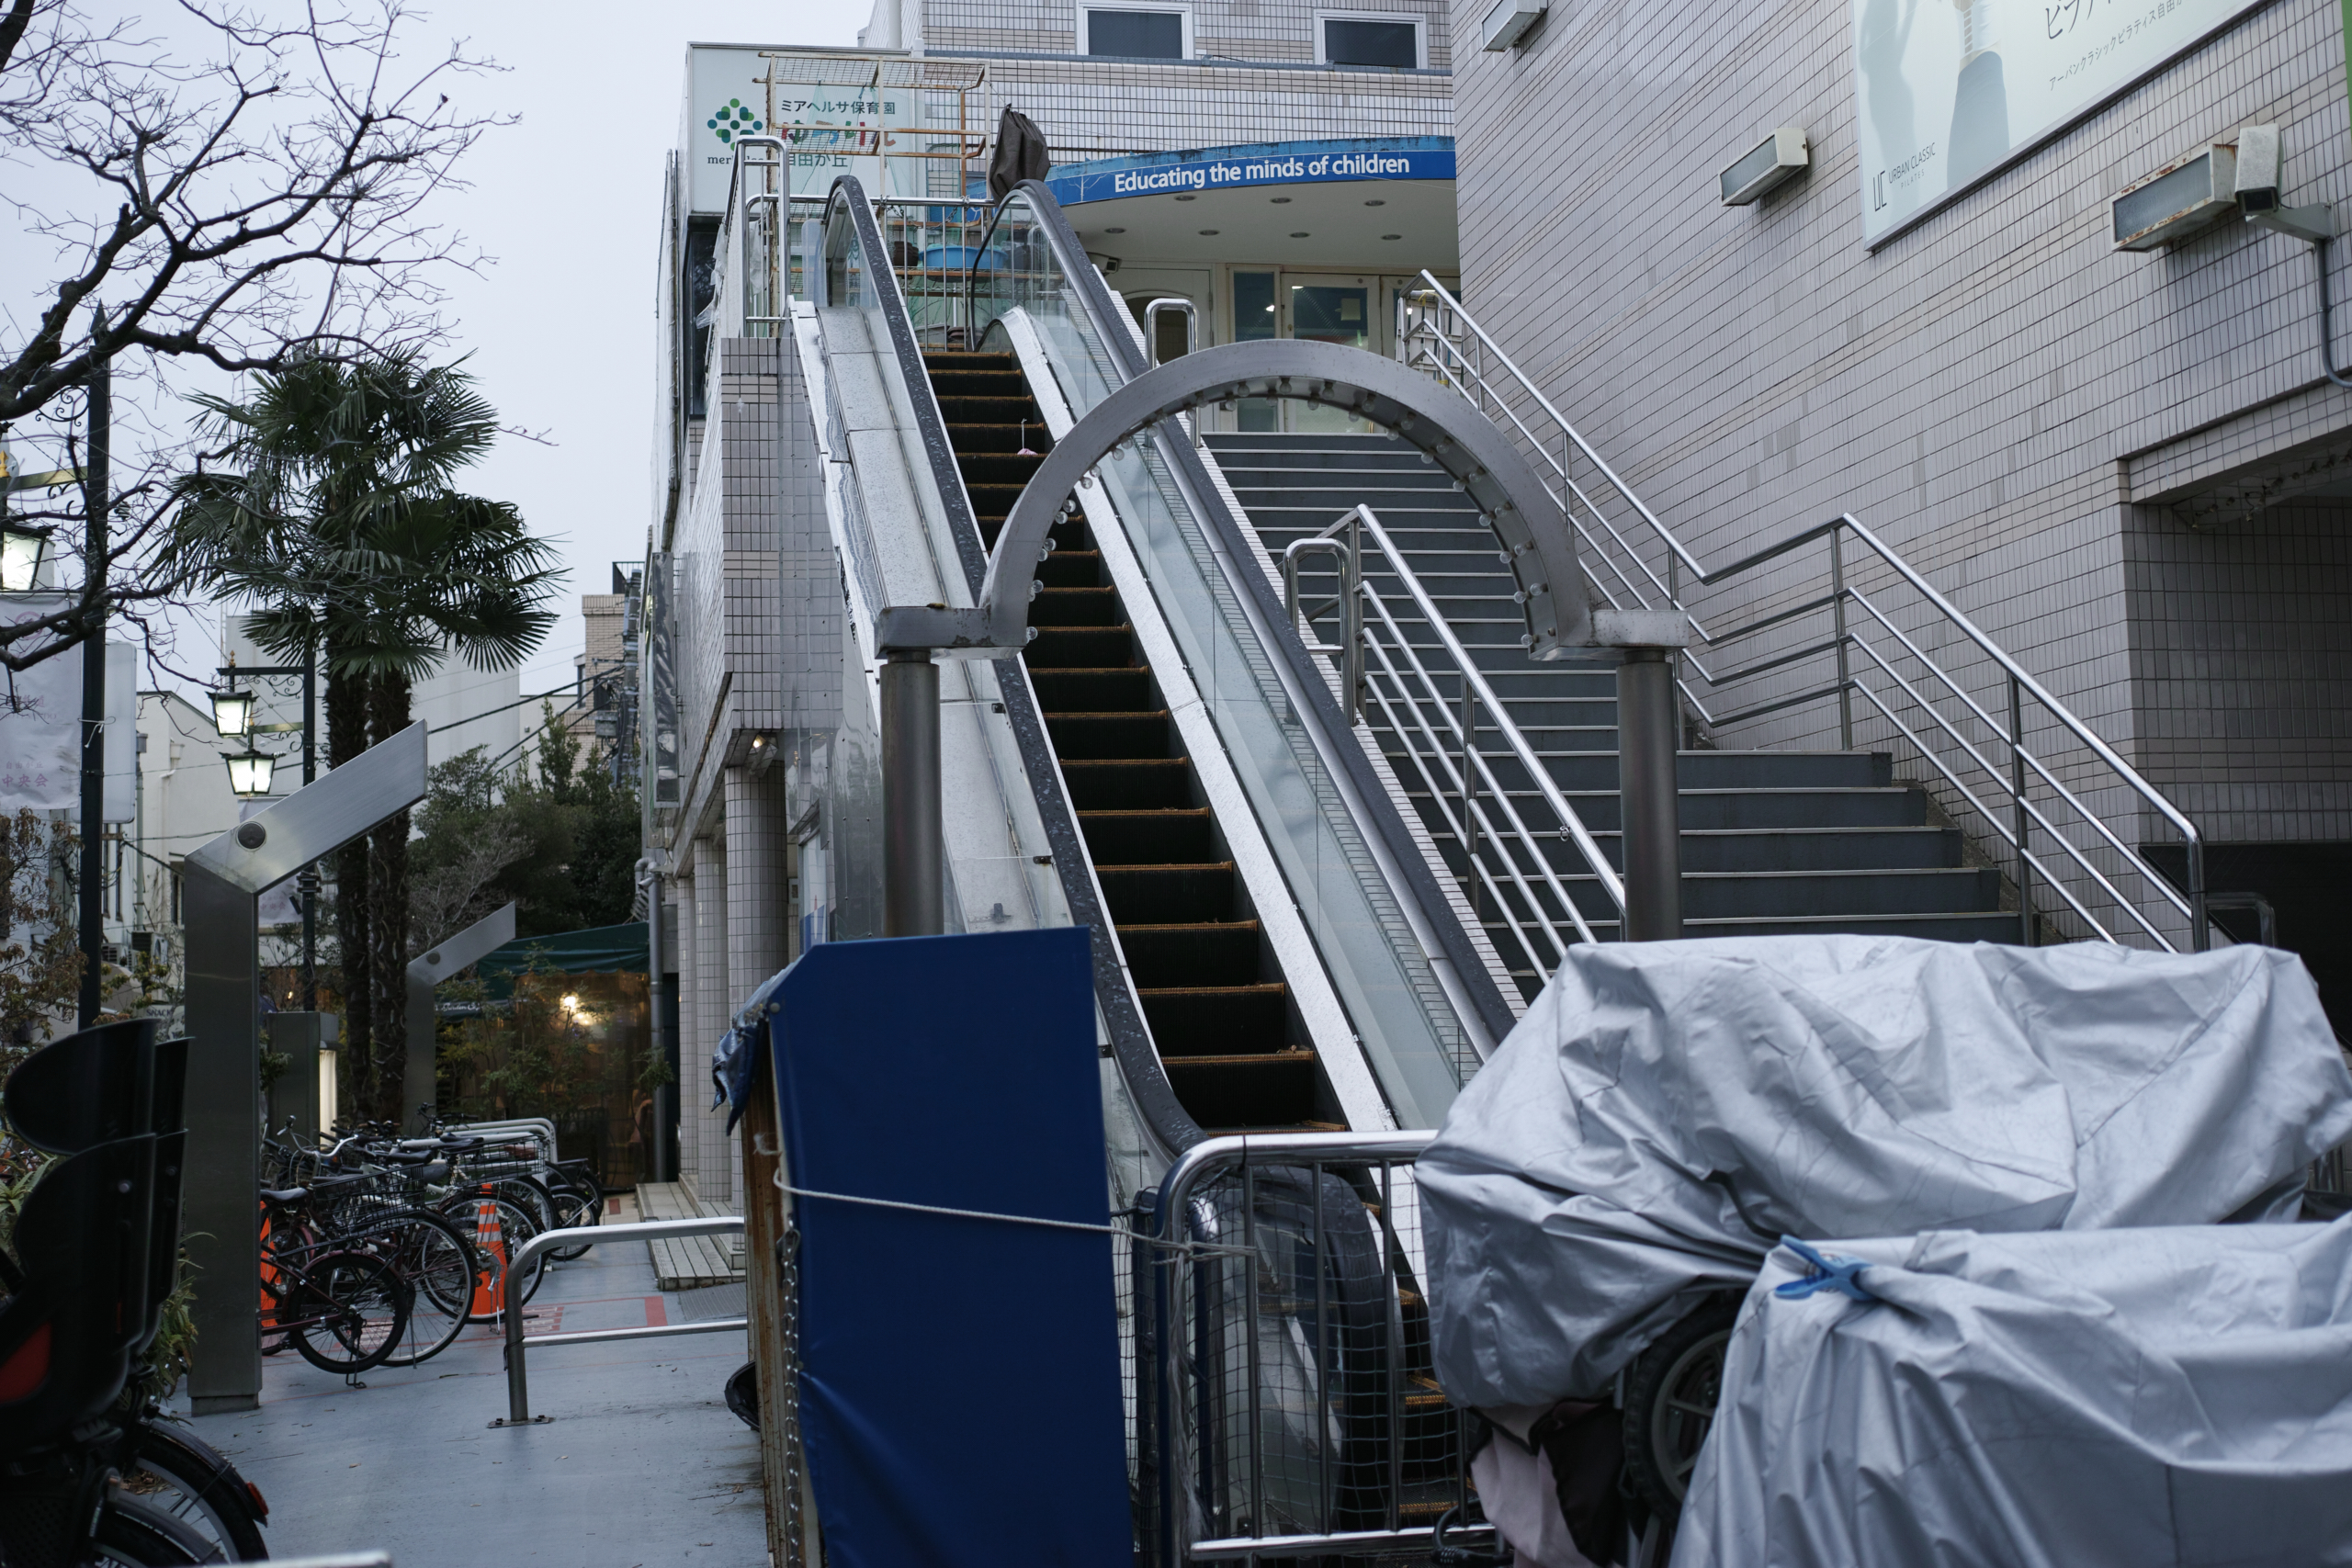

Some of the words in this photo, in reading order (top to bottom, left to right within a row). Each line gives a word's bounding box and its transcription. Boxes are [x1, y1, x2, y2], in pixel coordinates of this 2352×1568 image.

[781, 99, 896, 115] ミアヘルサ保育園
[1114, 166, 1205, 193] Educating
[1209, 163, 1241, 183] the
[1246, 157, 1304, 180] minds
[1308, 155, 1329, 175] of
[1332, 153, 1409, 175] children
[1888, 160, 1910, 184] URBAN
[1910, 141, 1936, 169] CLASSIC
[1900, 168, 1925, 189] PILATES
[1, 773, 49, 788] 中央会
